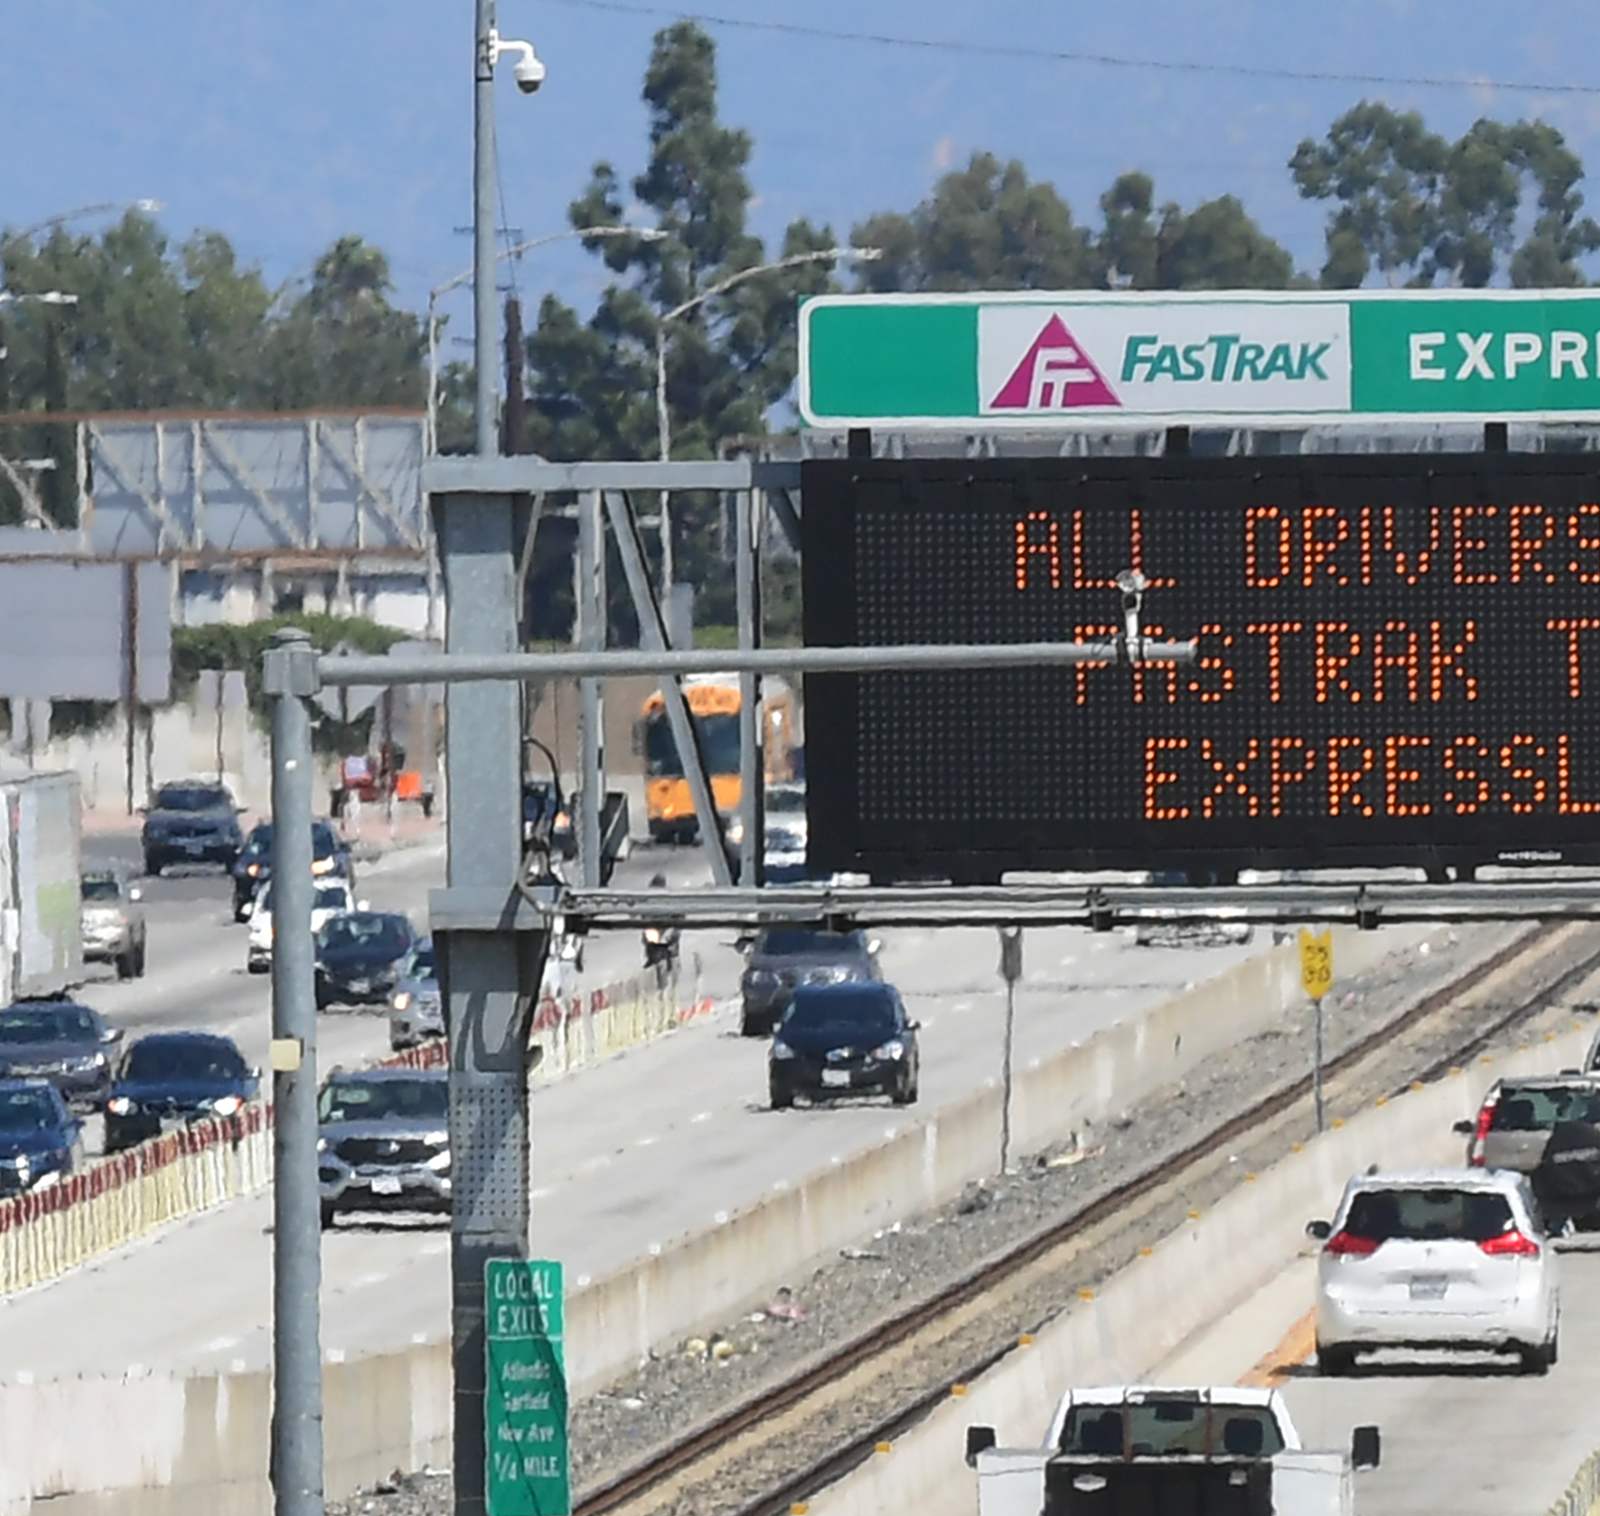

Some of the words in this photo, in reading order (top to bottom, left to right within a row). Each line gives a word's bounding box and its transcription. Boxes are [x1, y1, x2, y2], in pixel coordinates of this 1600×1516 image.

[1014, 510, 1177, 590] ALL
[494, 1269, 554, 1299] LOCAL
[497, 1304, 549, 1334] EXITS
[524, 1456, 560, 1478] MILE
